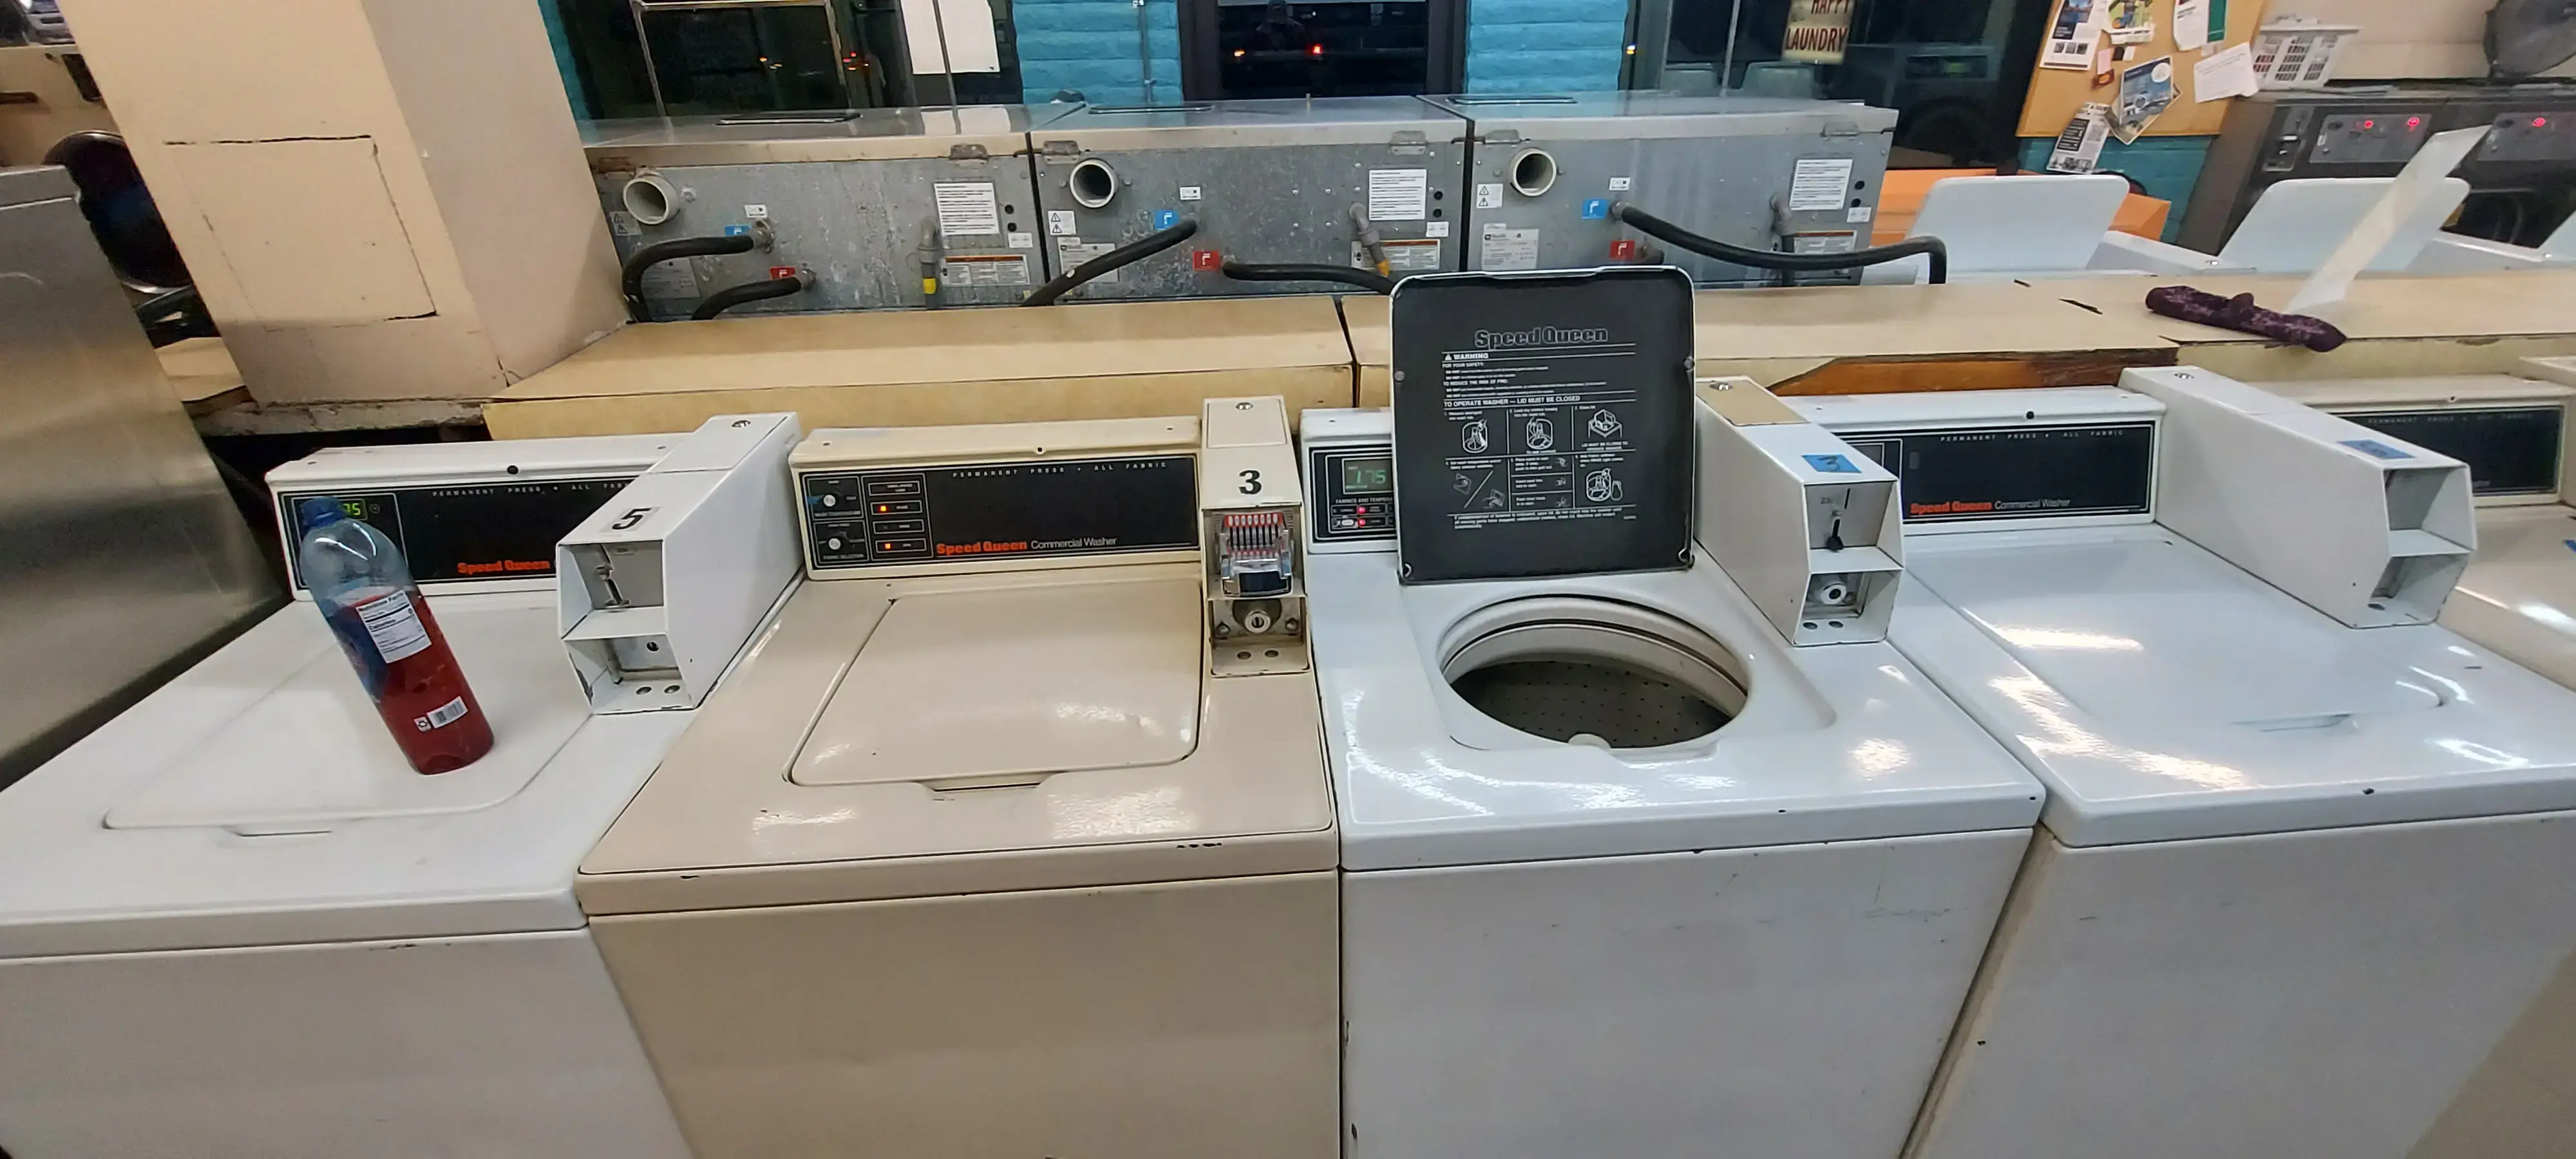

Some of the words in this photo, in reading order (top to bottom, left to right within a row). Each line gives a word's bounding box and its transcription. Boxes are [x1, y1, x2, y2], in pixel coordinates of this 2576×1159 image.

[1786, 28, 1848, 52] LAUNDRY
[1474, 327, 1541, 351] Speed
[1542, 326, 1608, 344] Queen
[952, 469, 1018, 478] PERMANENT
[1238, 470, 1262, 495] 3
[432, 488, 495, 497] PERMANENT
[1910, 501, 1950, 514] Speed
[1952, 500, 1993, 511] Queen
[1994, 499, 2040, 510] Commercial
[2041, 498, 2071, 508] Washer
[611, 507, 652, 531] 5
[936, 542, 981, 556] Speed
[983, 541, 1028, 552] Queen
[1030, 538, 1083, 549] Commercial
[1083, 536, 1118, 547] Washer
[457, 561, 503, 575] Speed
[504, 560, 550, 571] Queen
